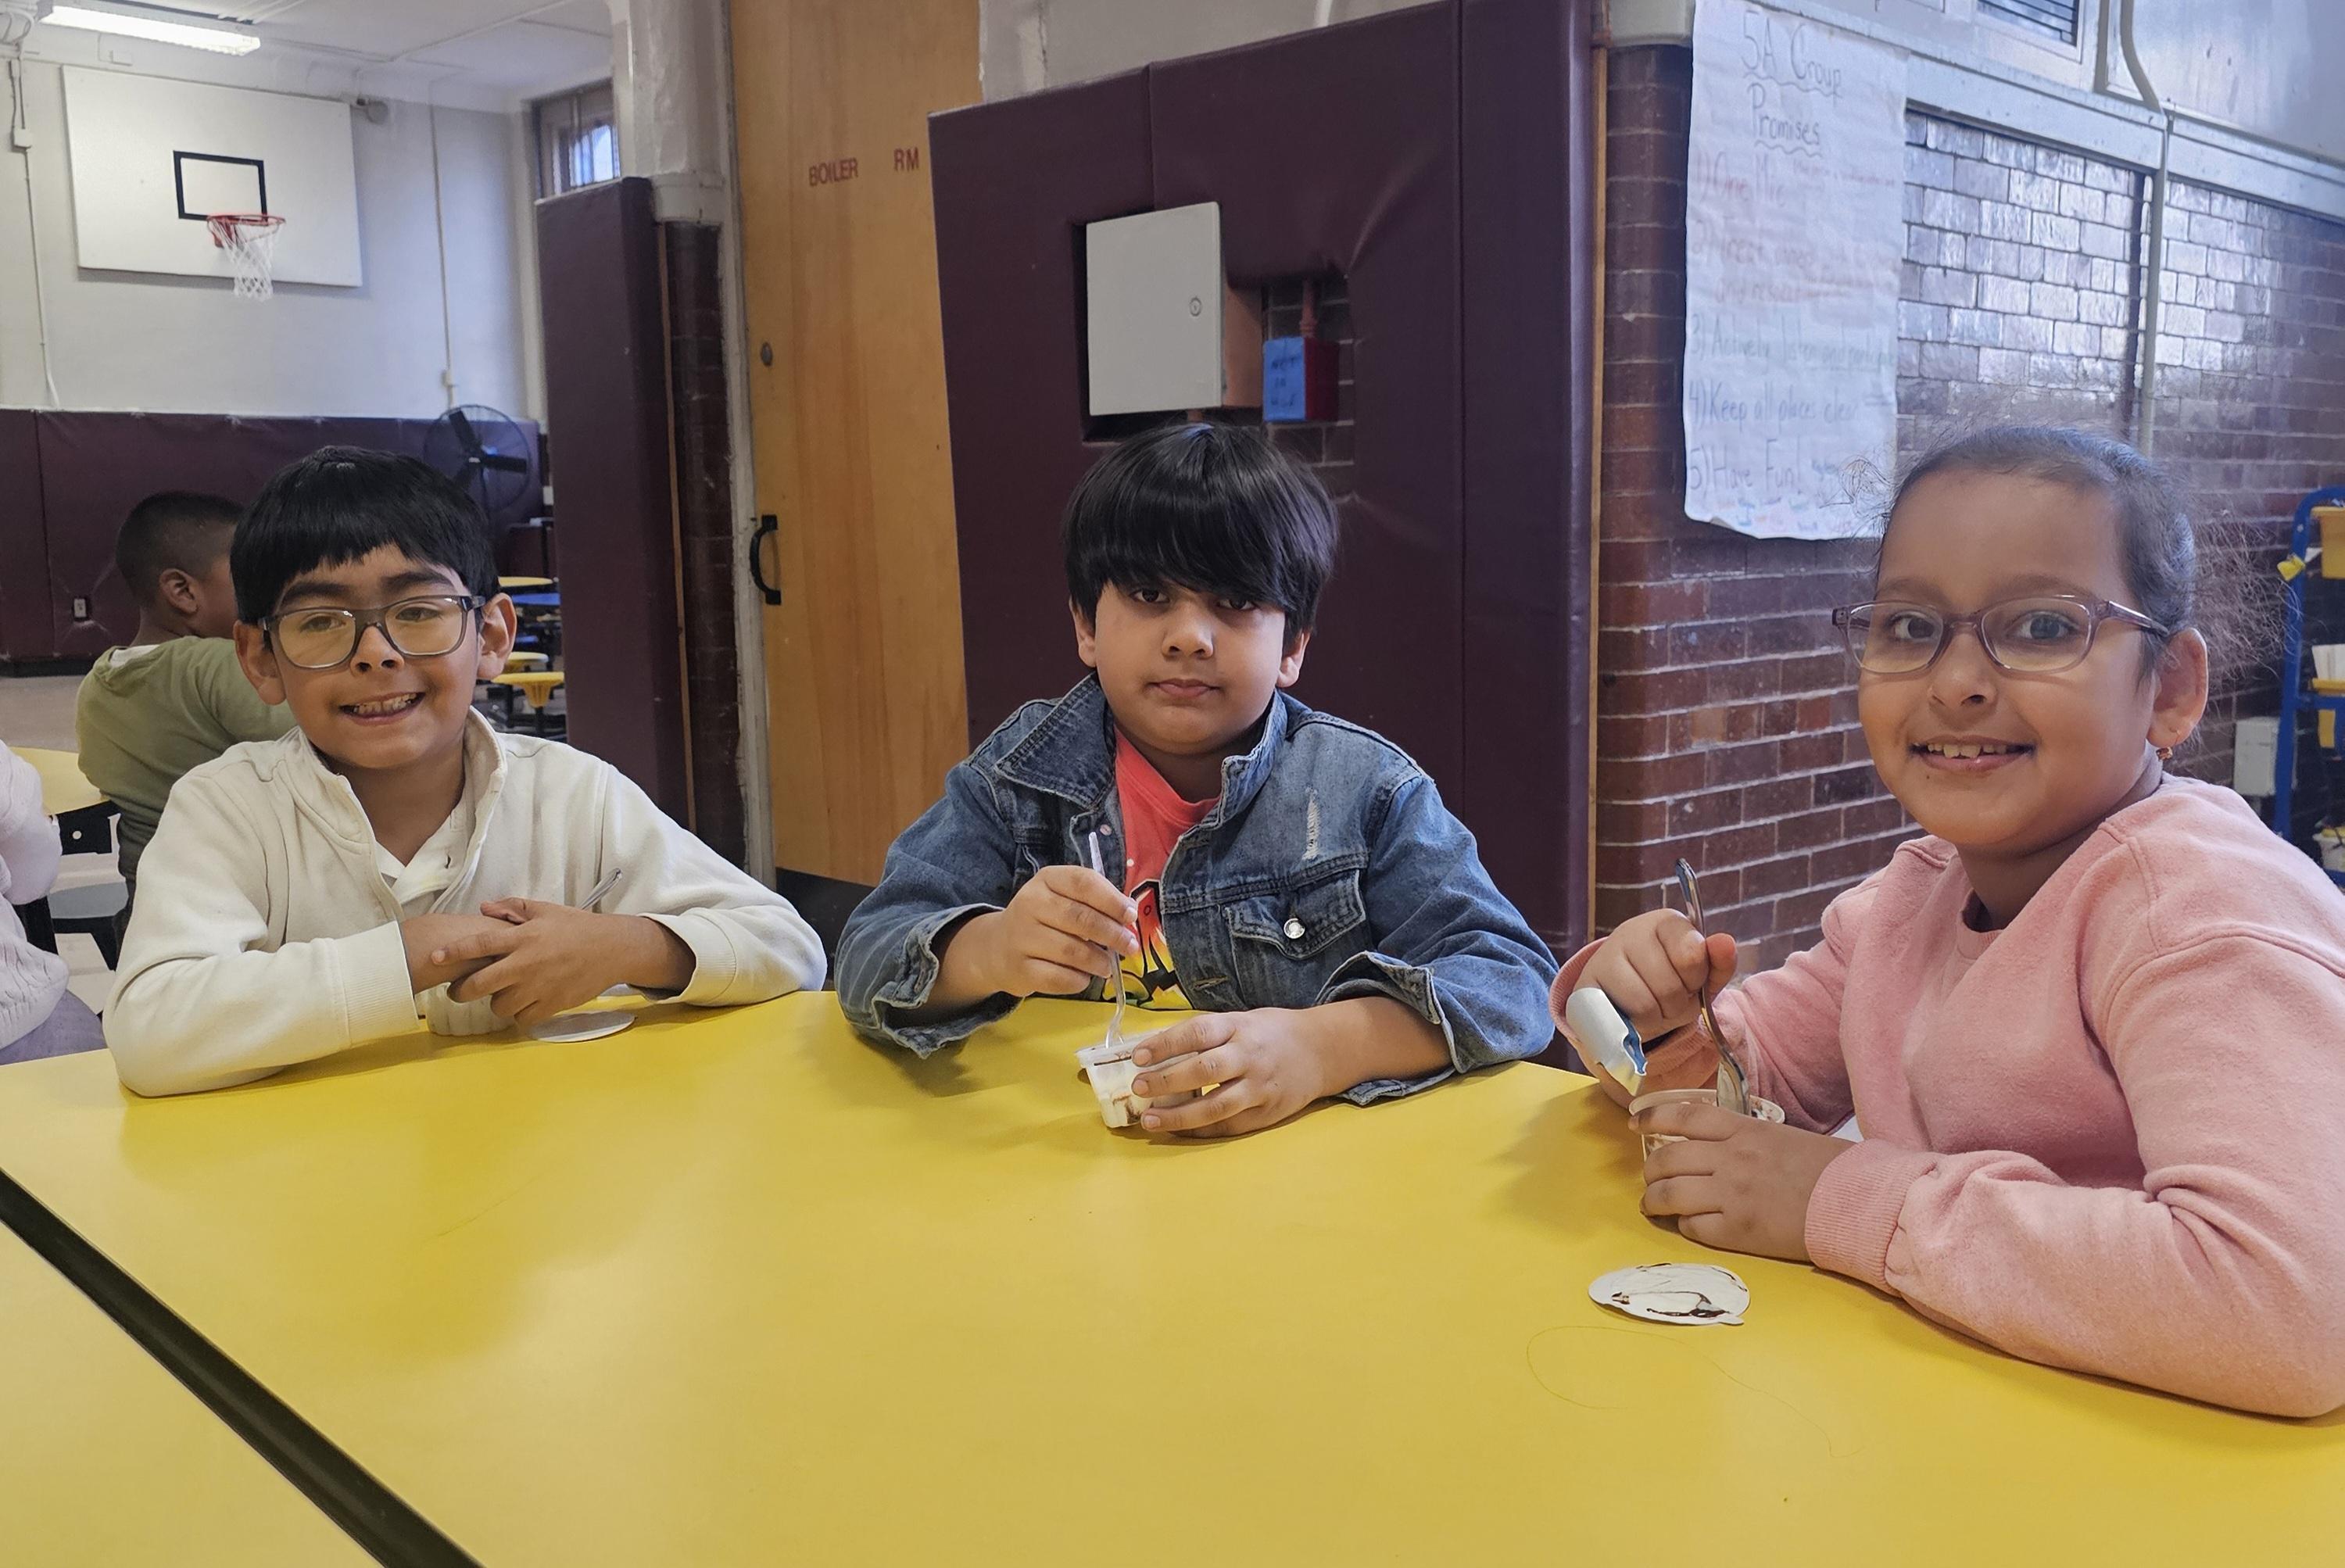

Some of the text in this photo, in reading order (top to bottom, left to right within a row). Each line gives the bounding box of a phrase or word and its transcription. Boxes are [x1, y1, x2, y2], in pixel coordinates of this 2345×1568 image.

[1742, 10, 1777, 73] 5A
[1747, 83, 1821, 146] Promises
[809, 147, 919, 187] BOILER RM
[1710, 378, 1748, 432] Keep
[1753, 381, 1773, 421] all
[1711, 445, 1753, 492] Have
